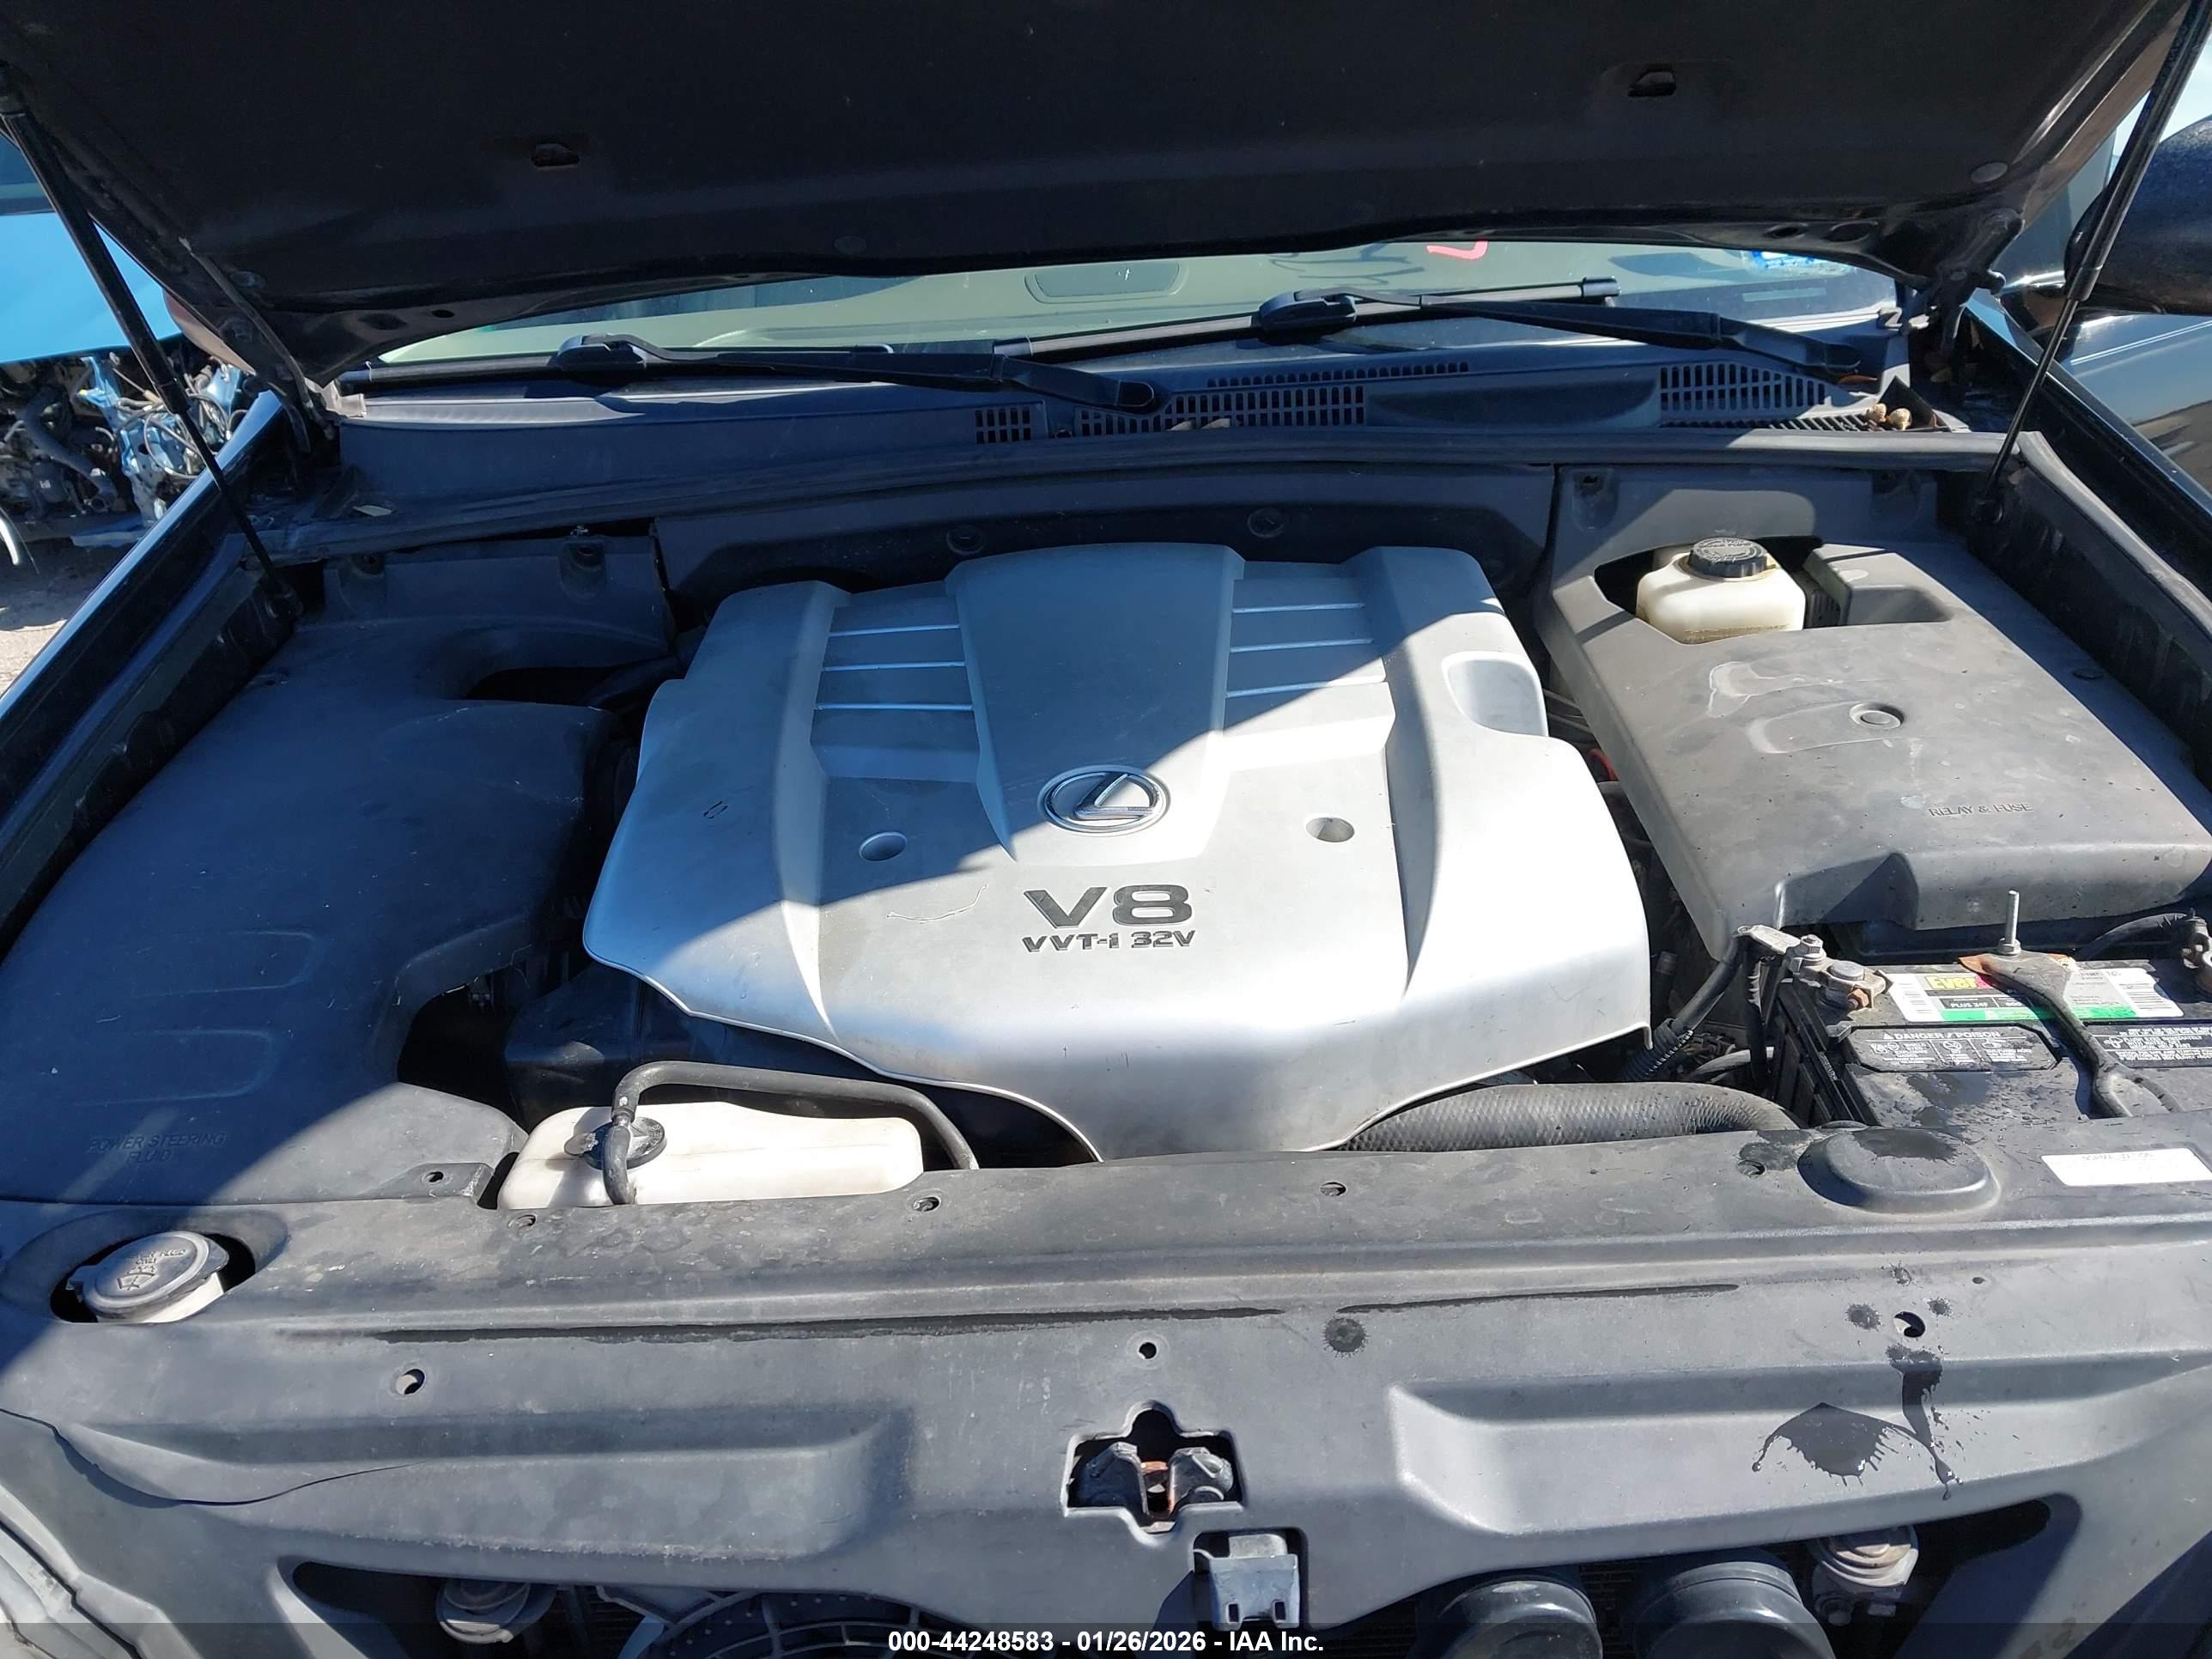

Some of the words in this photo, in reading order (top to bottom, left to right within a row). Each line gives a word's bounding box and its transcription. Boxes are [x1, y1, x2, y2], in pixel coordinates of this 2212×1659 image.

[1928, 806, 1972, 817] RELAY
[1993, 803, 2033, 812] FUSE
[1023, 884, 1193, 928] V8
[1131, 930, 1196, 949] 32V
[88, 1136, 145, 1152] POWER
[149, 1133, 228, 1147] STEERING
[129, 1151, 173, 1163] FLUID
